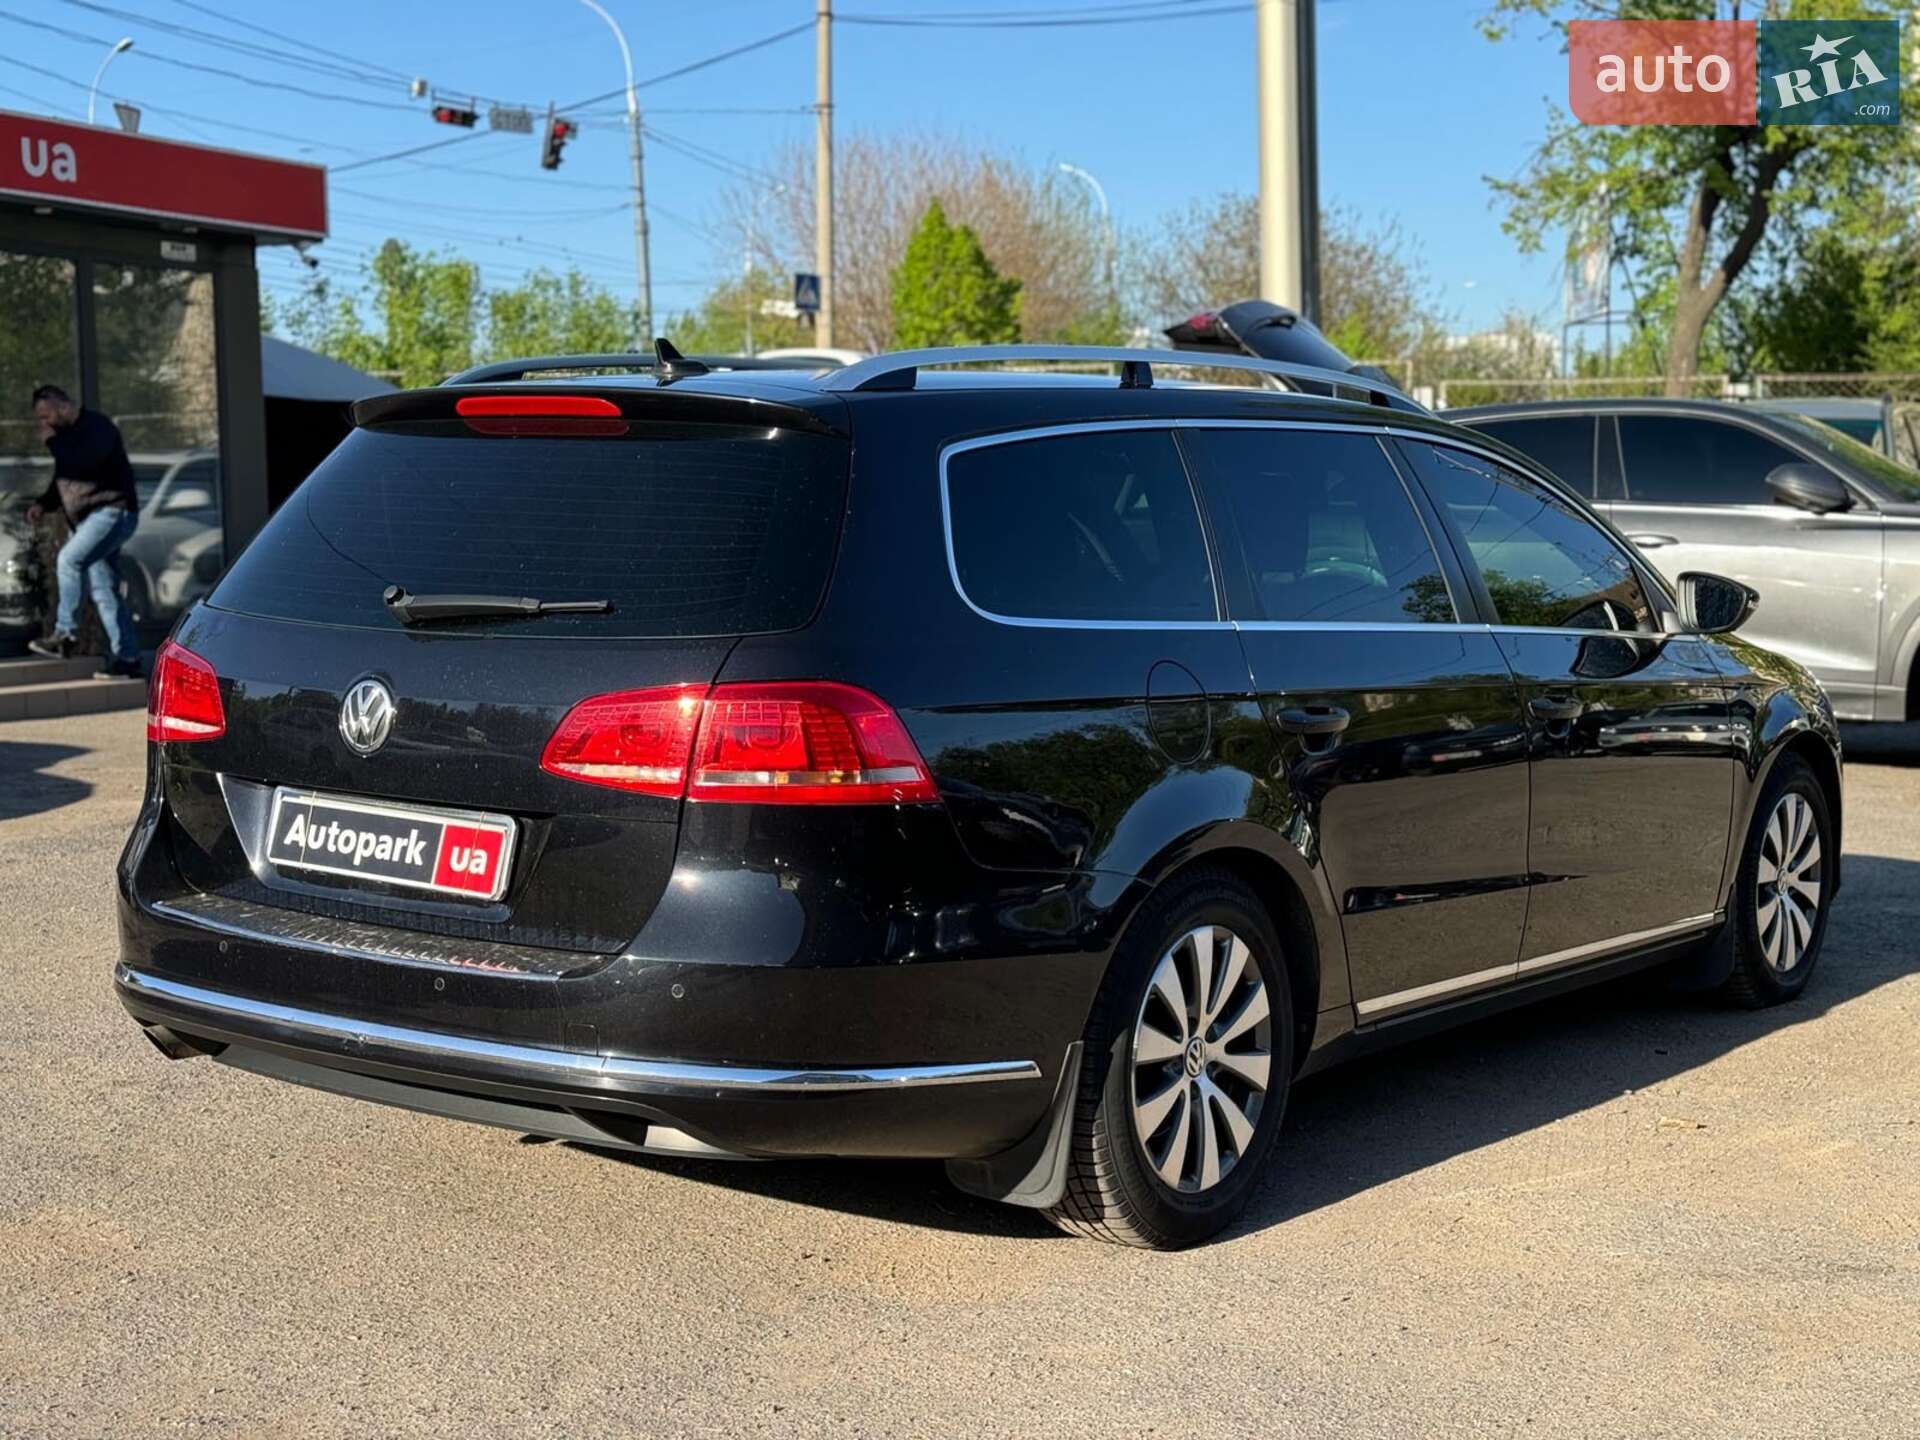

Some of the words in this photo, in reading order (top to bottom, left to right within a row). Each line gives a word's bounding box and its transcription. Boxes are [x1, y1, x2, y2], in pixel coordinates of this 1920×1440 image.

[20, 136, 78, 183] ua
[283, 813, 427, 866] Autopark
[449, 845, 489, 875] ua
